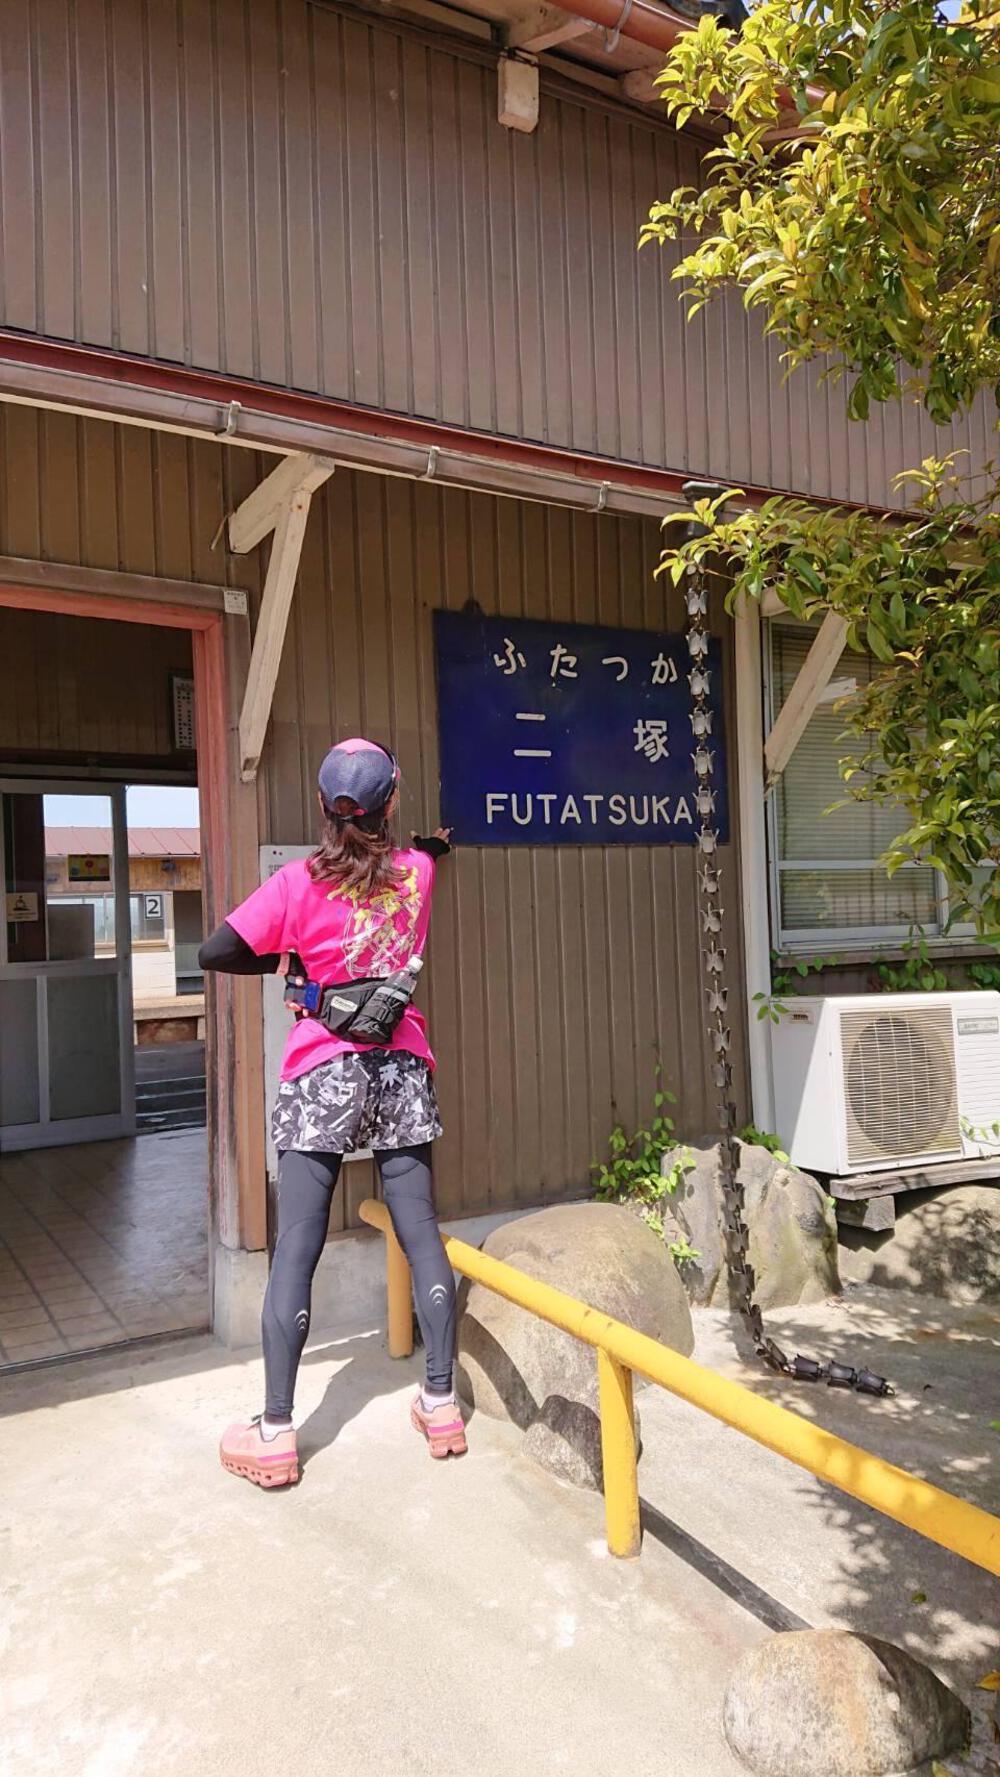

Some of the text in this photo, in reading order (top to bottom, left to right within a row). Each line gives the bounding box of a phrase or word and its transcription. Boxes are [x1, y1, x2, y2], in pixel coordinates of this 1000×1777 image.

[493, 637, 678, 685] ふたつか
[513, 712, 671, 763] 二塚
[485, 793, 693, 825] FUTATSUKA
[148, 899, 159, 914] 2
